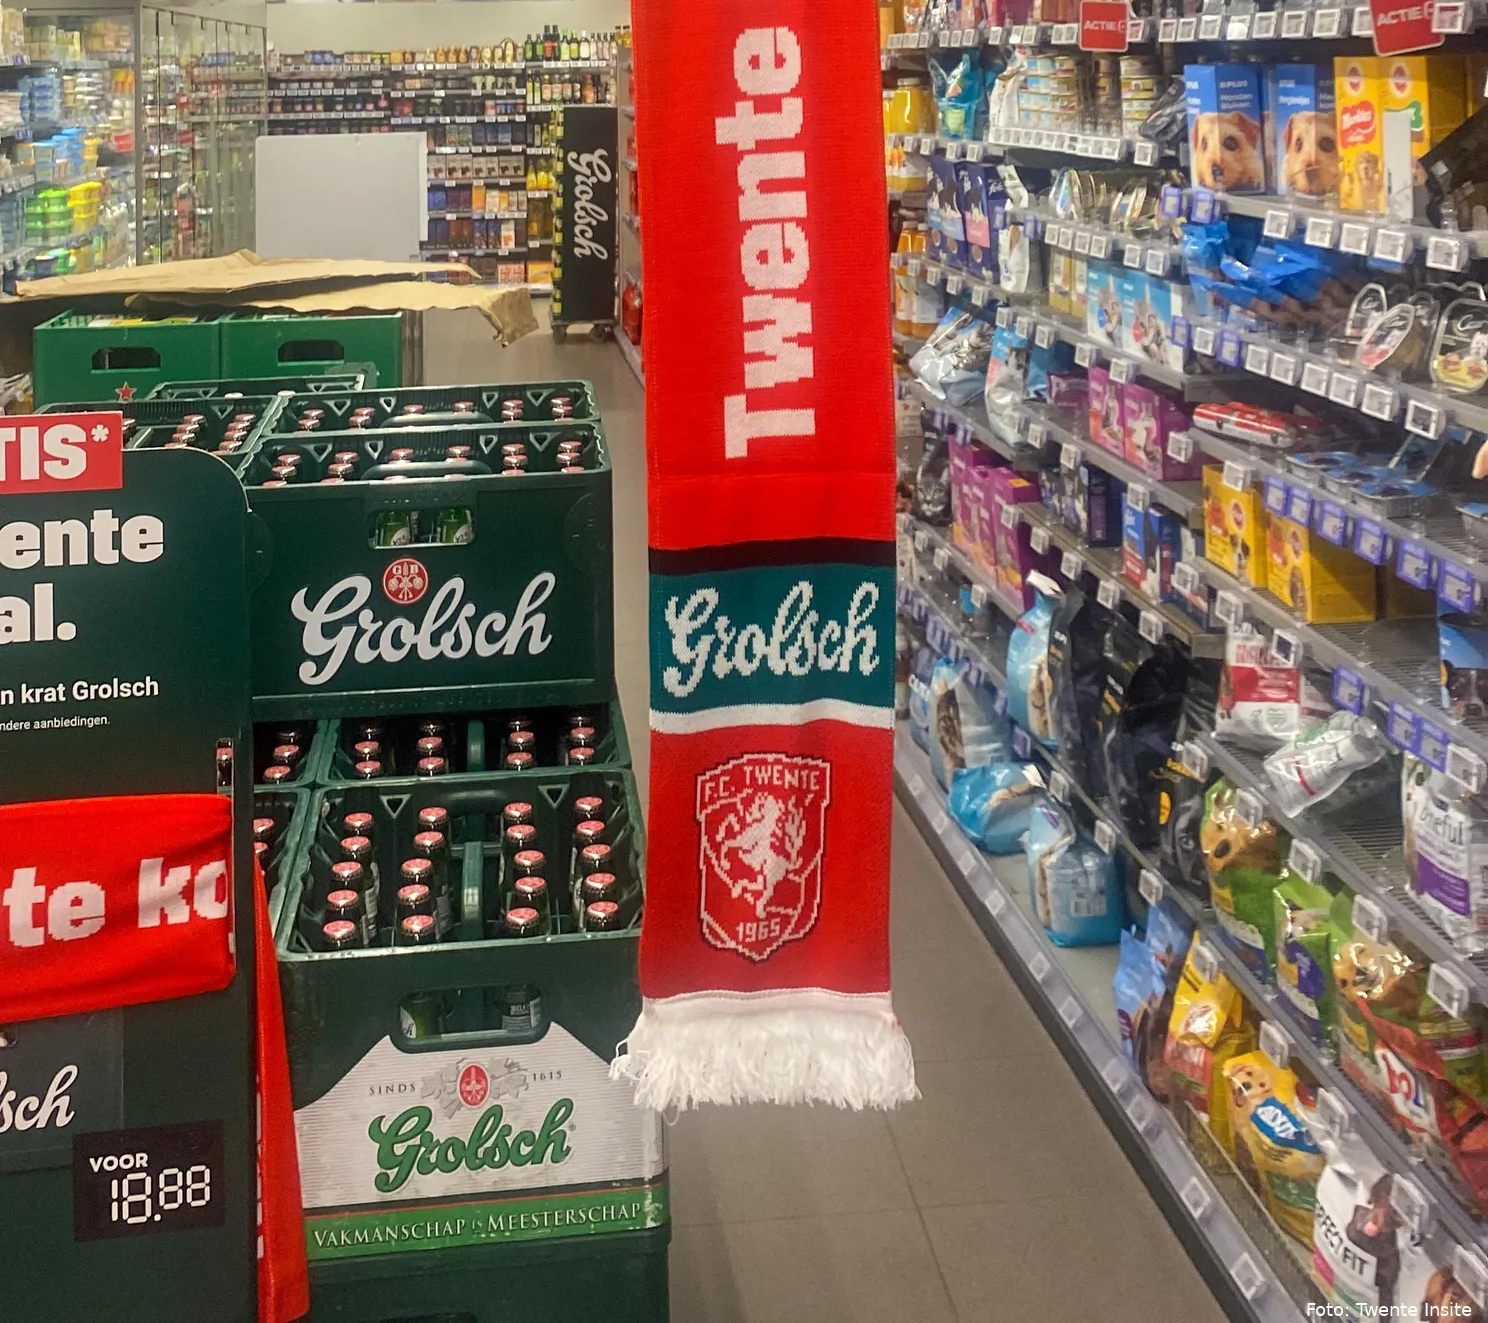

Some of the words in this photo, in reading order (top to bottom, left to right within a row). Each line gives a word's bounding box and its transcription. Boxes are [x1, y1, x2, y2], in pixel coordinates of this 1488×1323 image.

[1083, 20, 1117, 31] ACTIE
[1377, 6, 1423, 27] ACTIE
[567, 148, 612, 260] Grolsch
[715, 26, 816, 458] Twente
[0, 509, 164, 569] ente
[0, 583, 77, 642] al.
[291, 572, 556, 685] Grolsch
[663, 580, 880, 698] Grolsch
[21, 683, 66, 704] krat
[72, 676, 159, 700] Grolsch
[33, 715, 110, 729] aanbiedingen.
[744, 765, 820, 791] TWENTE
[2, 867, 106, 948] te
[736, 920, 781, 943] 1965
[369, 1083, 417, 1096] SINDS
[532, 1070, 563, 1082] 1615
[89, 1152, 149, 1173] VOOR
[368, 1098, 574, 1193] Grolsch
[111, 1165, 211, 1225] 18.88
[314, 1219, 466, 1248] VAKMANSCHAP
[488, 1202, 642, 1233] MEESTERSCHAP
[1343, 1246, 1369, 1276] FIT
